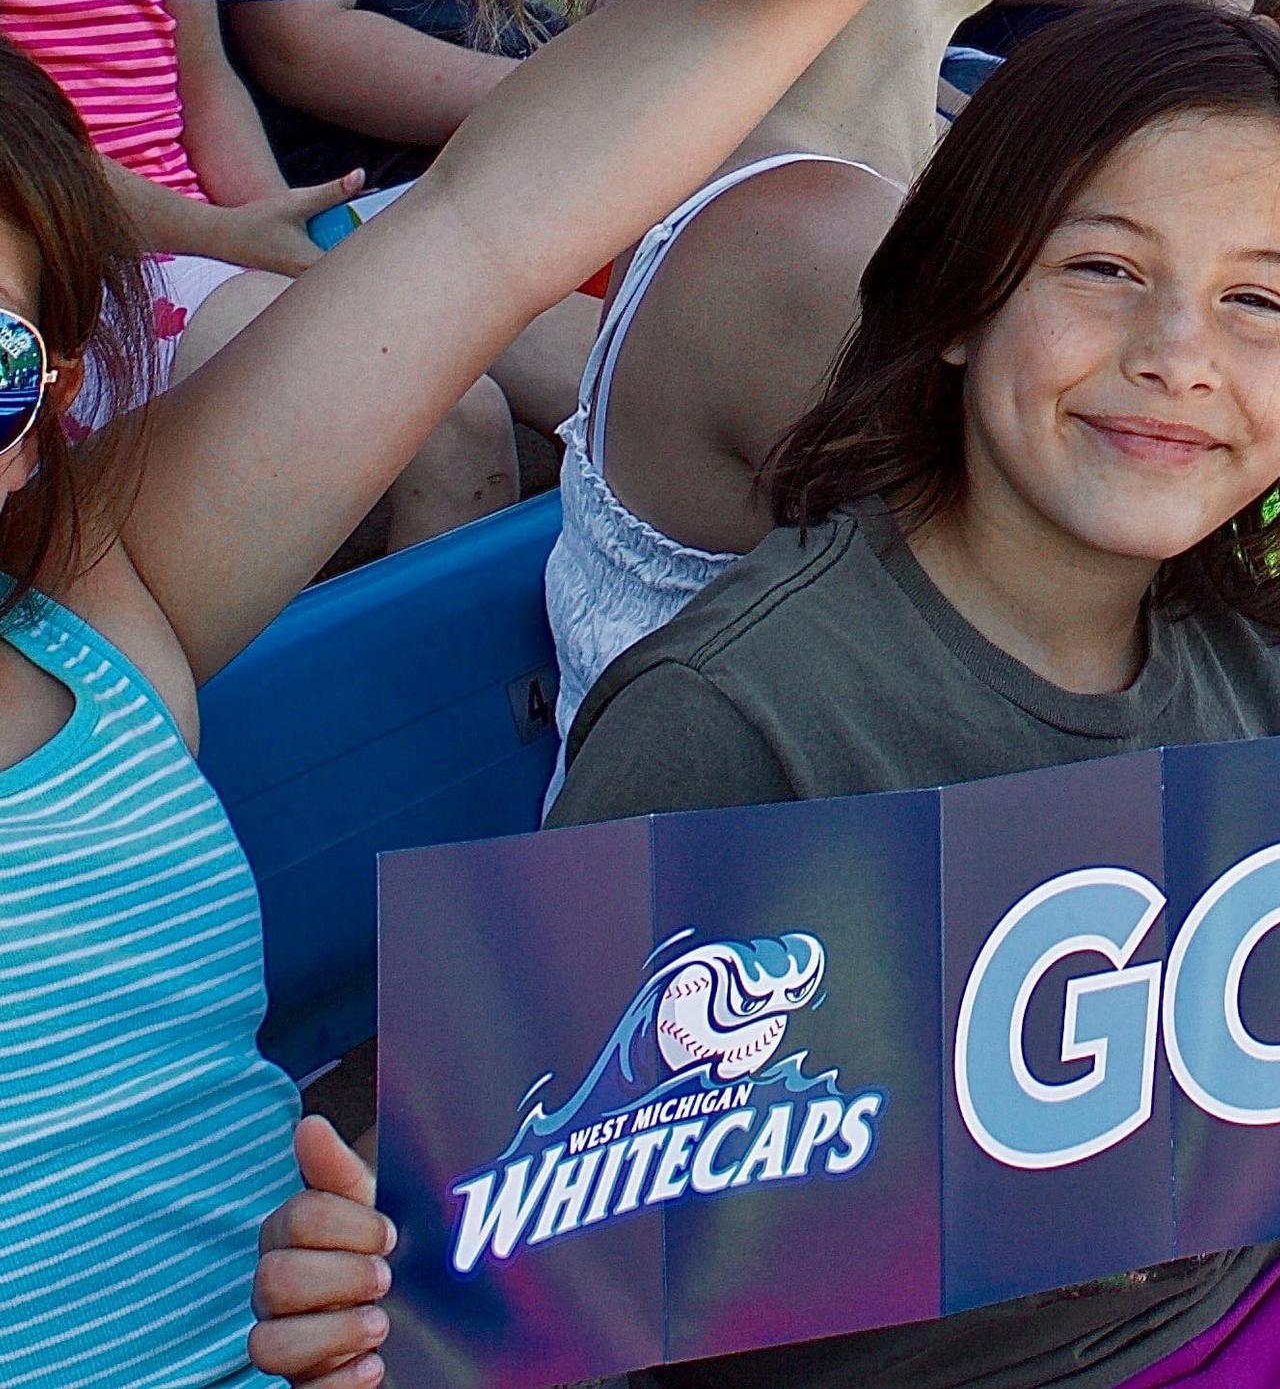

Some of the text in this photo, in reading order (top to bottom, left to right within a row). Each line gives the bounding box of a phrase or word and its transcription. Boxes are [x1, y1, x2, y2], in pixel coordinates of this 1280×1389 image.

[526, 676, 551, 727] 4
[568, 1082, 755, 1153] WEST MICHIGAN
[449, 1091, 883, 1273] WHITECAPS
